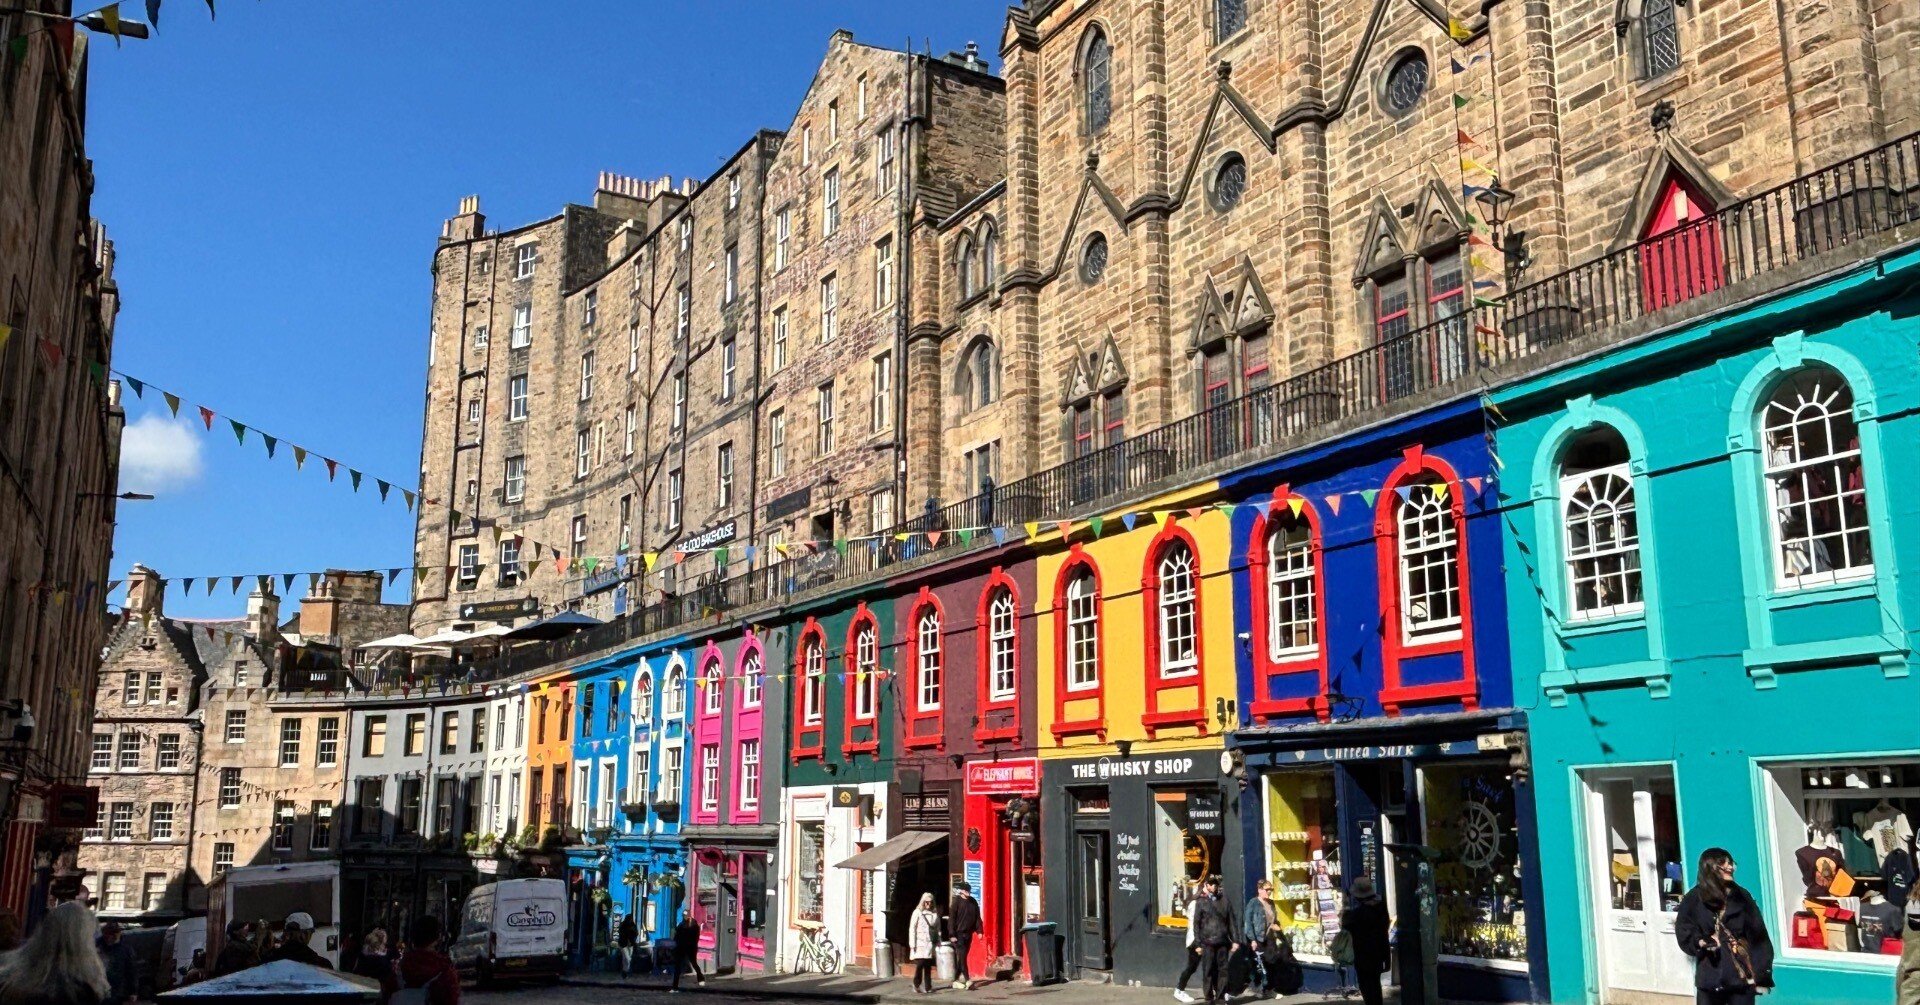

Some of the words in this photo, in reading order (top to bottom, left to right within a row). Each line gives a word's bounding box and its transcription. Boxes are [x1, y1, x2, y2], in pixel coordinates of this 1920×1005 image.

[1072, 764, 1096, 778] THE
[1099, 760, 1151, 777] WHISKY
[1154, 758, 1193, 774] SHOP
[1189, 810, 1220, 818] WHISKY
